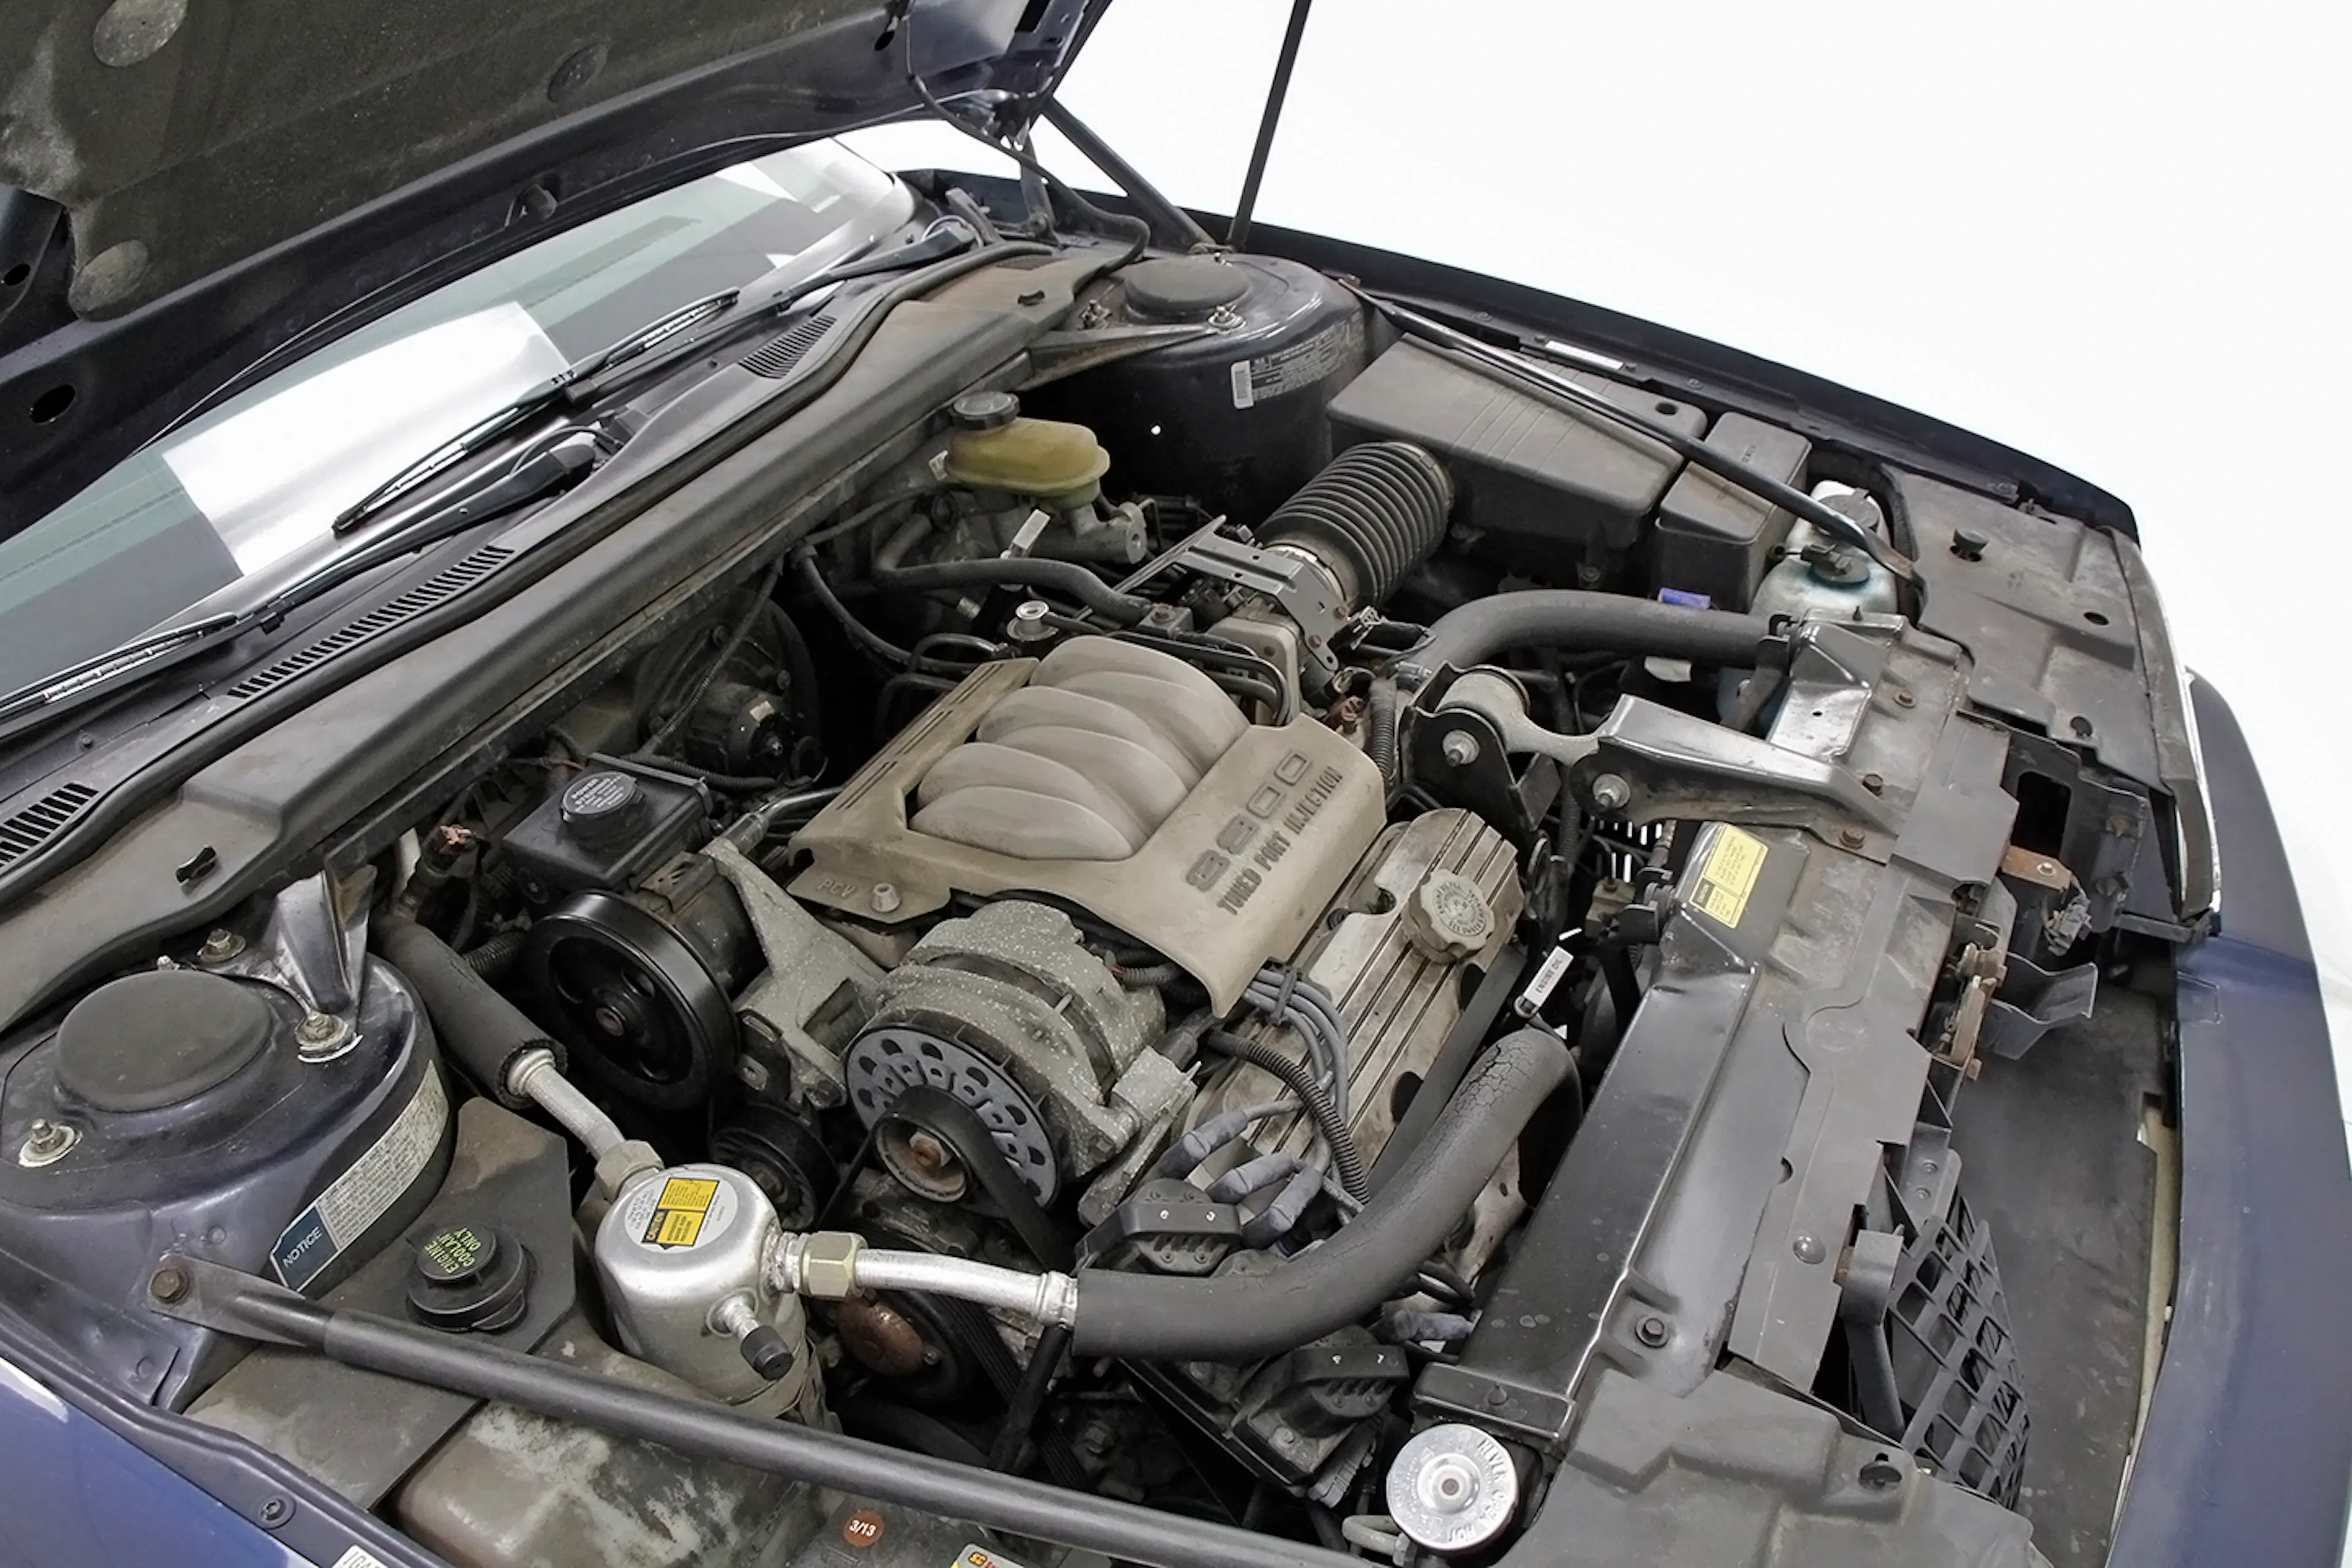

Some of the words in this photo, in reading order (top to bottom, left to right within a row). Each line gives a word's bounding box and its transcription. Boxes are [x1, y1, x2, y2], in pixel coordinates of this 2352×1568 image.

[1216, 868, 1262, 916] TUNED
[1253, 831, 1291, 872] PORT
[1282, 766, 1343, 835] INJECTION
[816, 878, 856, 897] PCV
[282, 1225, 323, 1268] NOTICE
[453, 1227, 482, 1252] ONLY
[423, 1240, 460, 1274] ENGINE
[848, 1519, 877, 1537] 3/13
